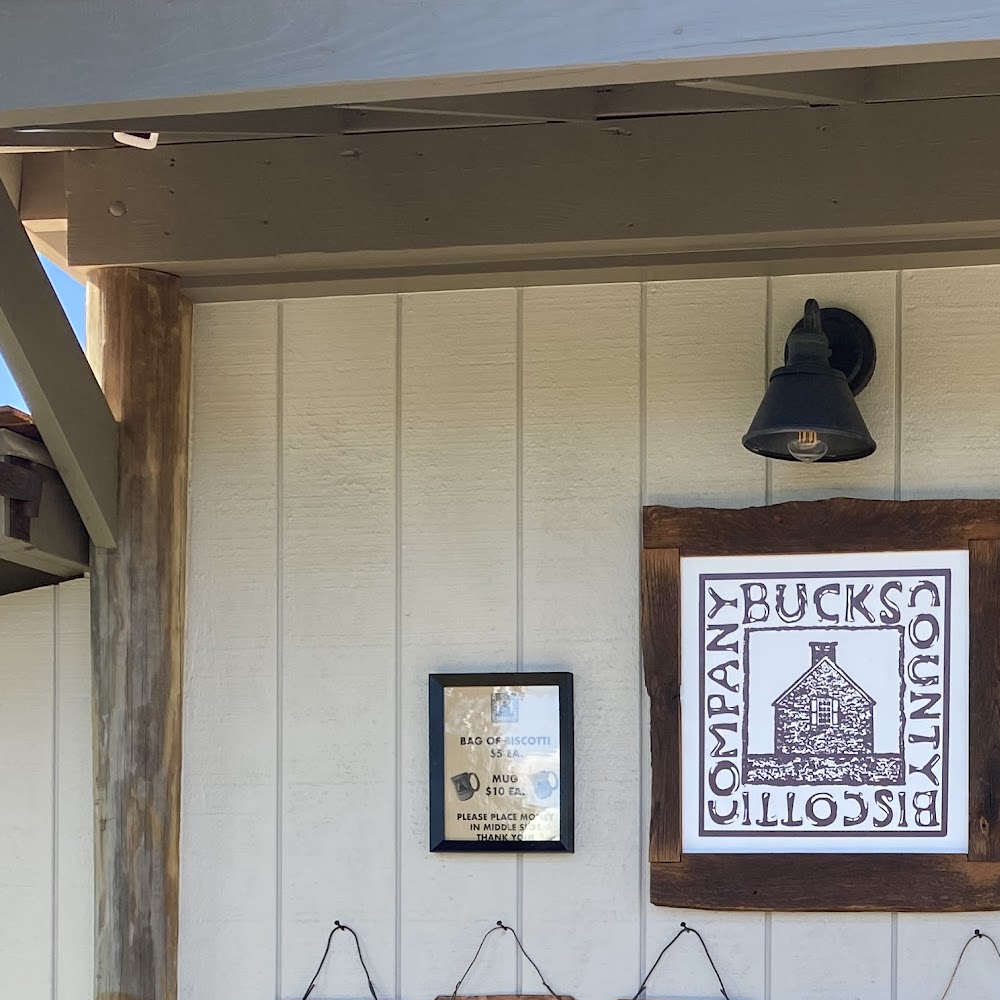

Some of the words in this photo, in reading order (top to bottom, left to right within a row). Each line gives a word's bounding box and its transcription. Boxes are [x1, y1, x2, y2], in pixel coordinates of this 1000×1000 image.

[740, 581, 903, 624] BUCKS
[907, 580, 941, 787] COUNTY
[706, 586, 740, 827] COMPANY
[460, 736, 483, 745] BAG
[486, 736, 500, 745] OF
[504, 736, 551, 745] BISCOTTI
[490, 748, 503, 758] $5
[507, 749, 523, 758] EA.
[492, 774, 518, 783] MUG
[485, 786, 505, 797] $10
[508, 787, 526, 796] EA.
[741, 788, 940, 828] BISCOTTI
[457, 813, 487, 821] PLEASE
[490, 813, 517, 821] PLACE
[520, 813, 554, 821] MOEY
[470, 823, 480, 831] IN
[483, 823, 516, 831] MIDDLE
[476, 833, 508, 841] THANK
